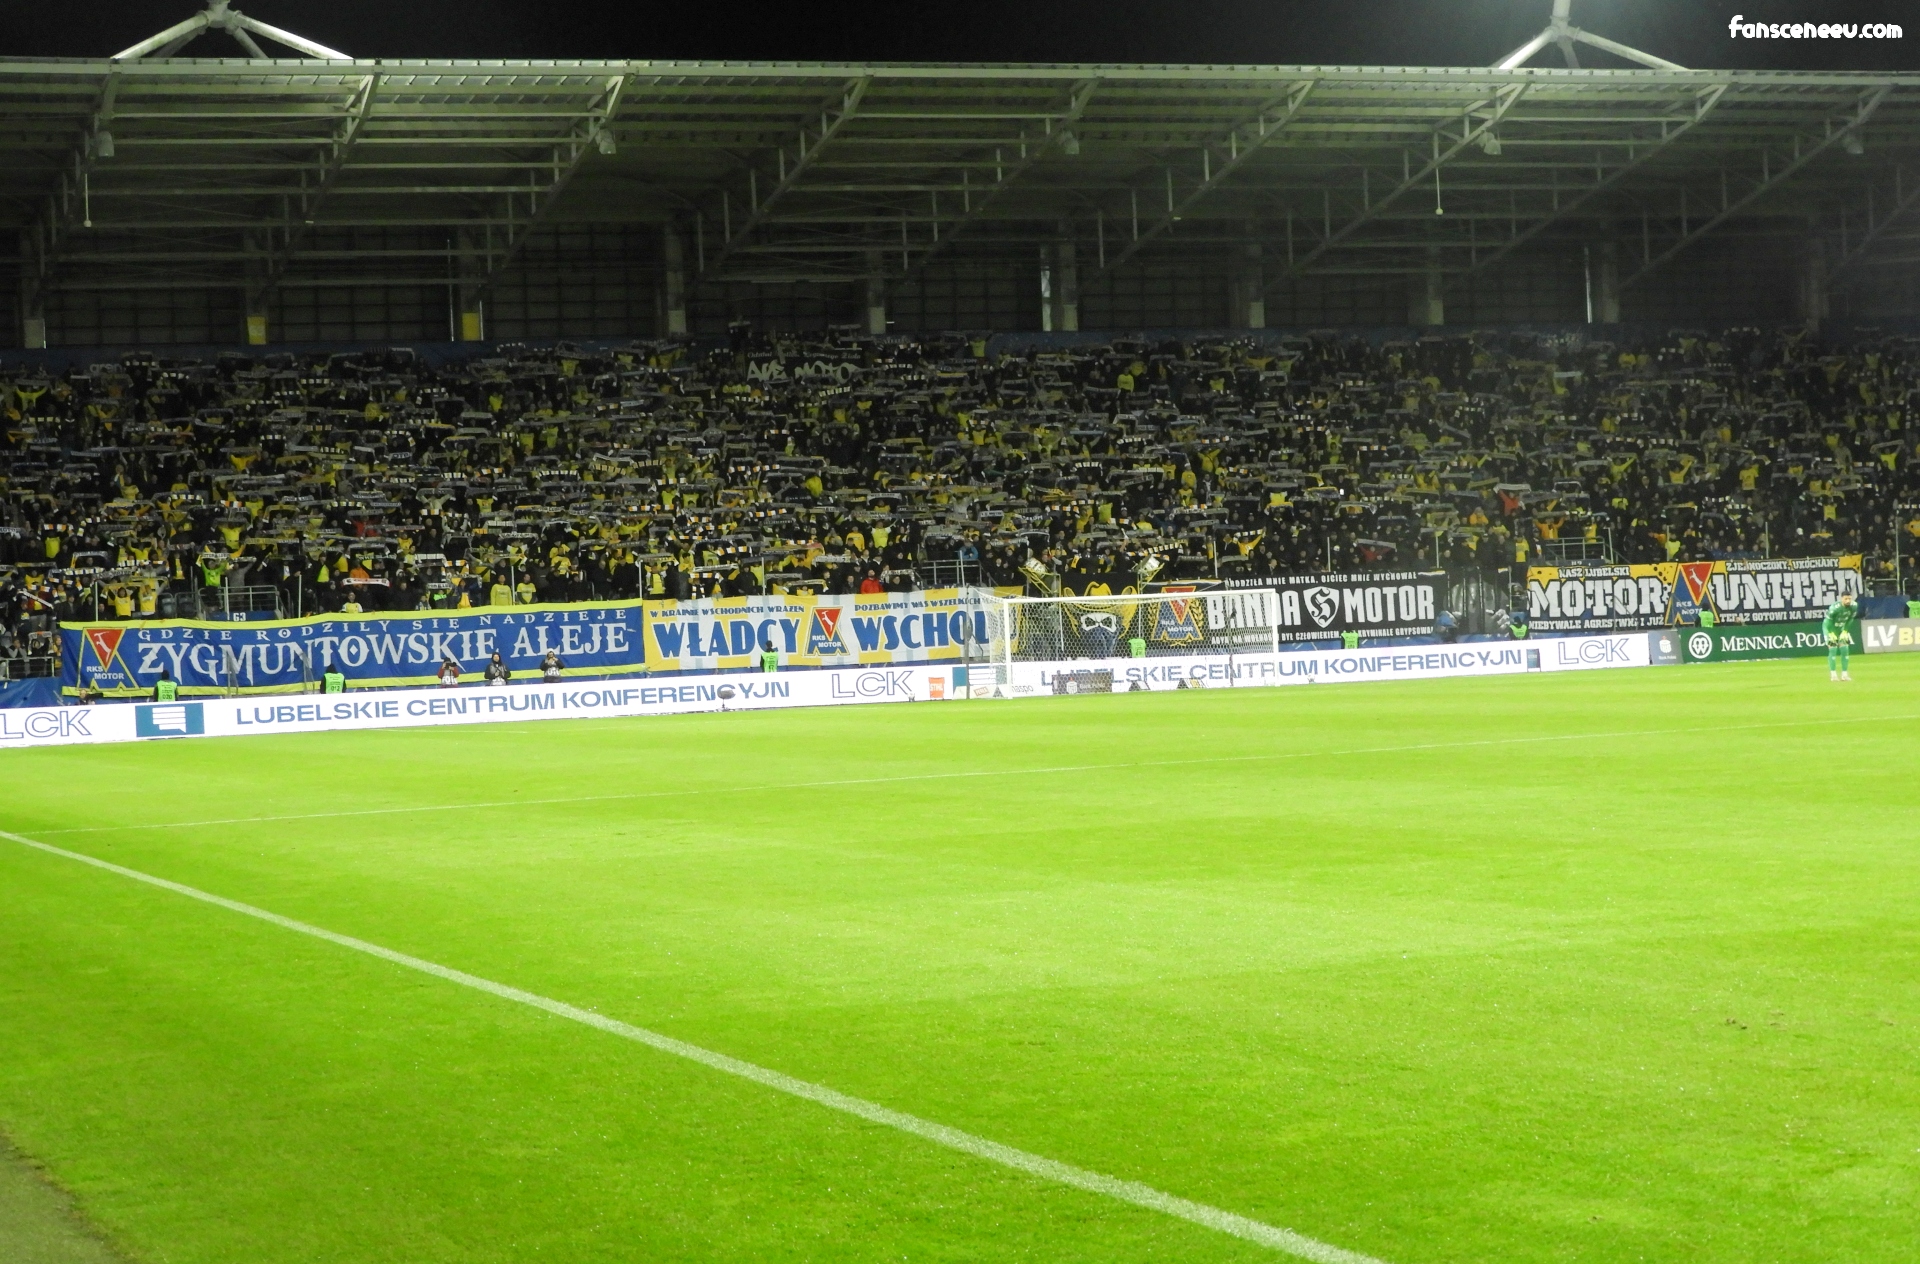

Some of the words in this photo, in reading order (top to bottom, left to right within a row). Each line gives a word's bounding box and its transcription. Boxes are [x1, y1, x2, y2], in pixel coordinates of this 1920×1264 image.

[1265, 576, 1286, 585] MNIE
[1321, 574, 1348, 583] OJCIEC
[1351, 573, 1370, 582] MNIE
[1559, 567, 1583, 578] NASZ
[1585, 566, 1630, 577] LUBELSKI
[1528, 577, 1666, 618] MOTOR
[1713, 570, 1859, 611] UNITED
[649, 610, 659, 618] W
[662, 608, 699, 617] KRAINIE
[702, 606, 764, 616] WSCHODNICH
[855, 602, 909, 611] POZBAWIMY
[911, 600, 929, 609] WAS
[1207, 590, 1301, 630] BANDA
[1343, 585, 1435, 623] MOTOR
[1752, 610, 1787, 621] GOTOWI
[1789, 609, 1801, 620] NA
[138, 629, 232, 641] GDZIE
[479, 609, 626, 626] NADZIEJE
[1529, 619, 1582, 630] NIEBYWALE
[1647, 614, 1664, 626] JUŻ
[653, 618, 800, 658] WŁADCY
[1558, 638, 1630, 665] LCK
[1721, 633, 1793, 652] MENNICA
[86, 665, 103, 673] RKS
[94, 672, 125, 680] MOTOR
[1189, 659, 1318, 682] CENTRUM
[1324, 649, 1522, 675] KONFERENCYJN
[831, 670, 914, 699] LCK
[236, 700, 400, 725] LUBELSKIE
[407, 693, 555, 717] CENTRUM
[563, 681, 790, 708] KONFERENCYJN
[0, 709, 92, 739] LCK
